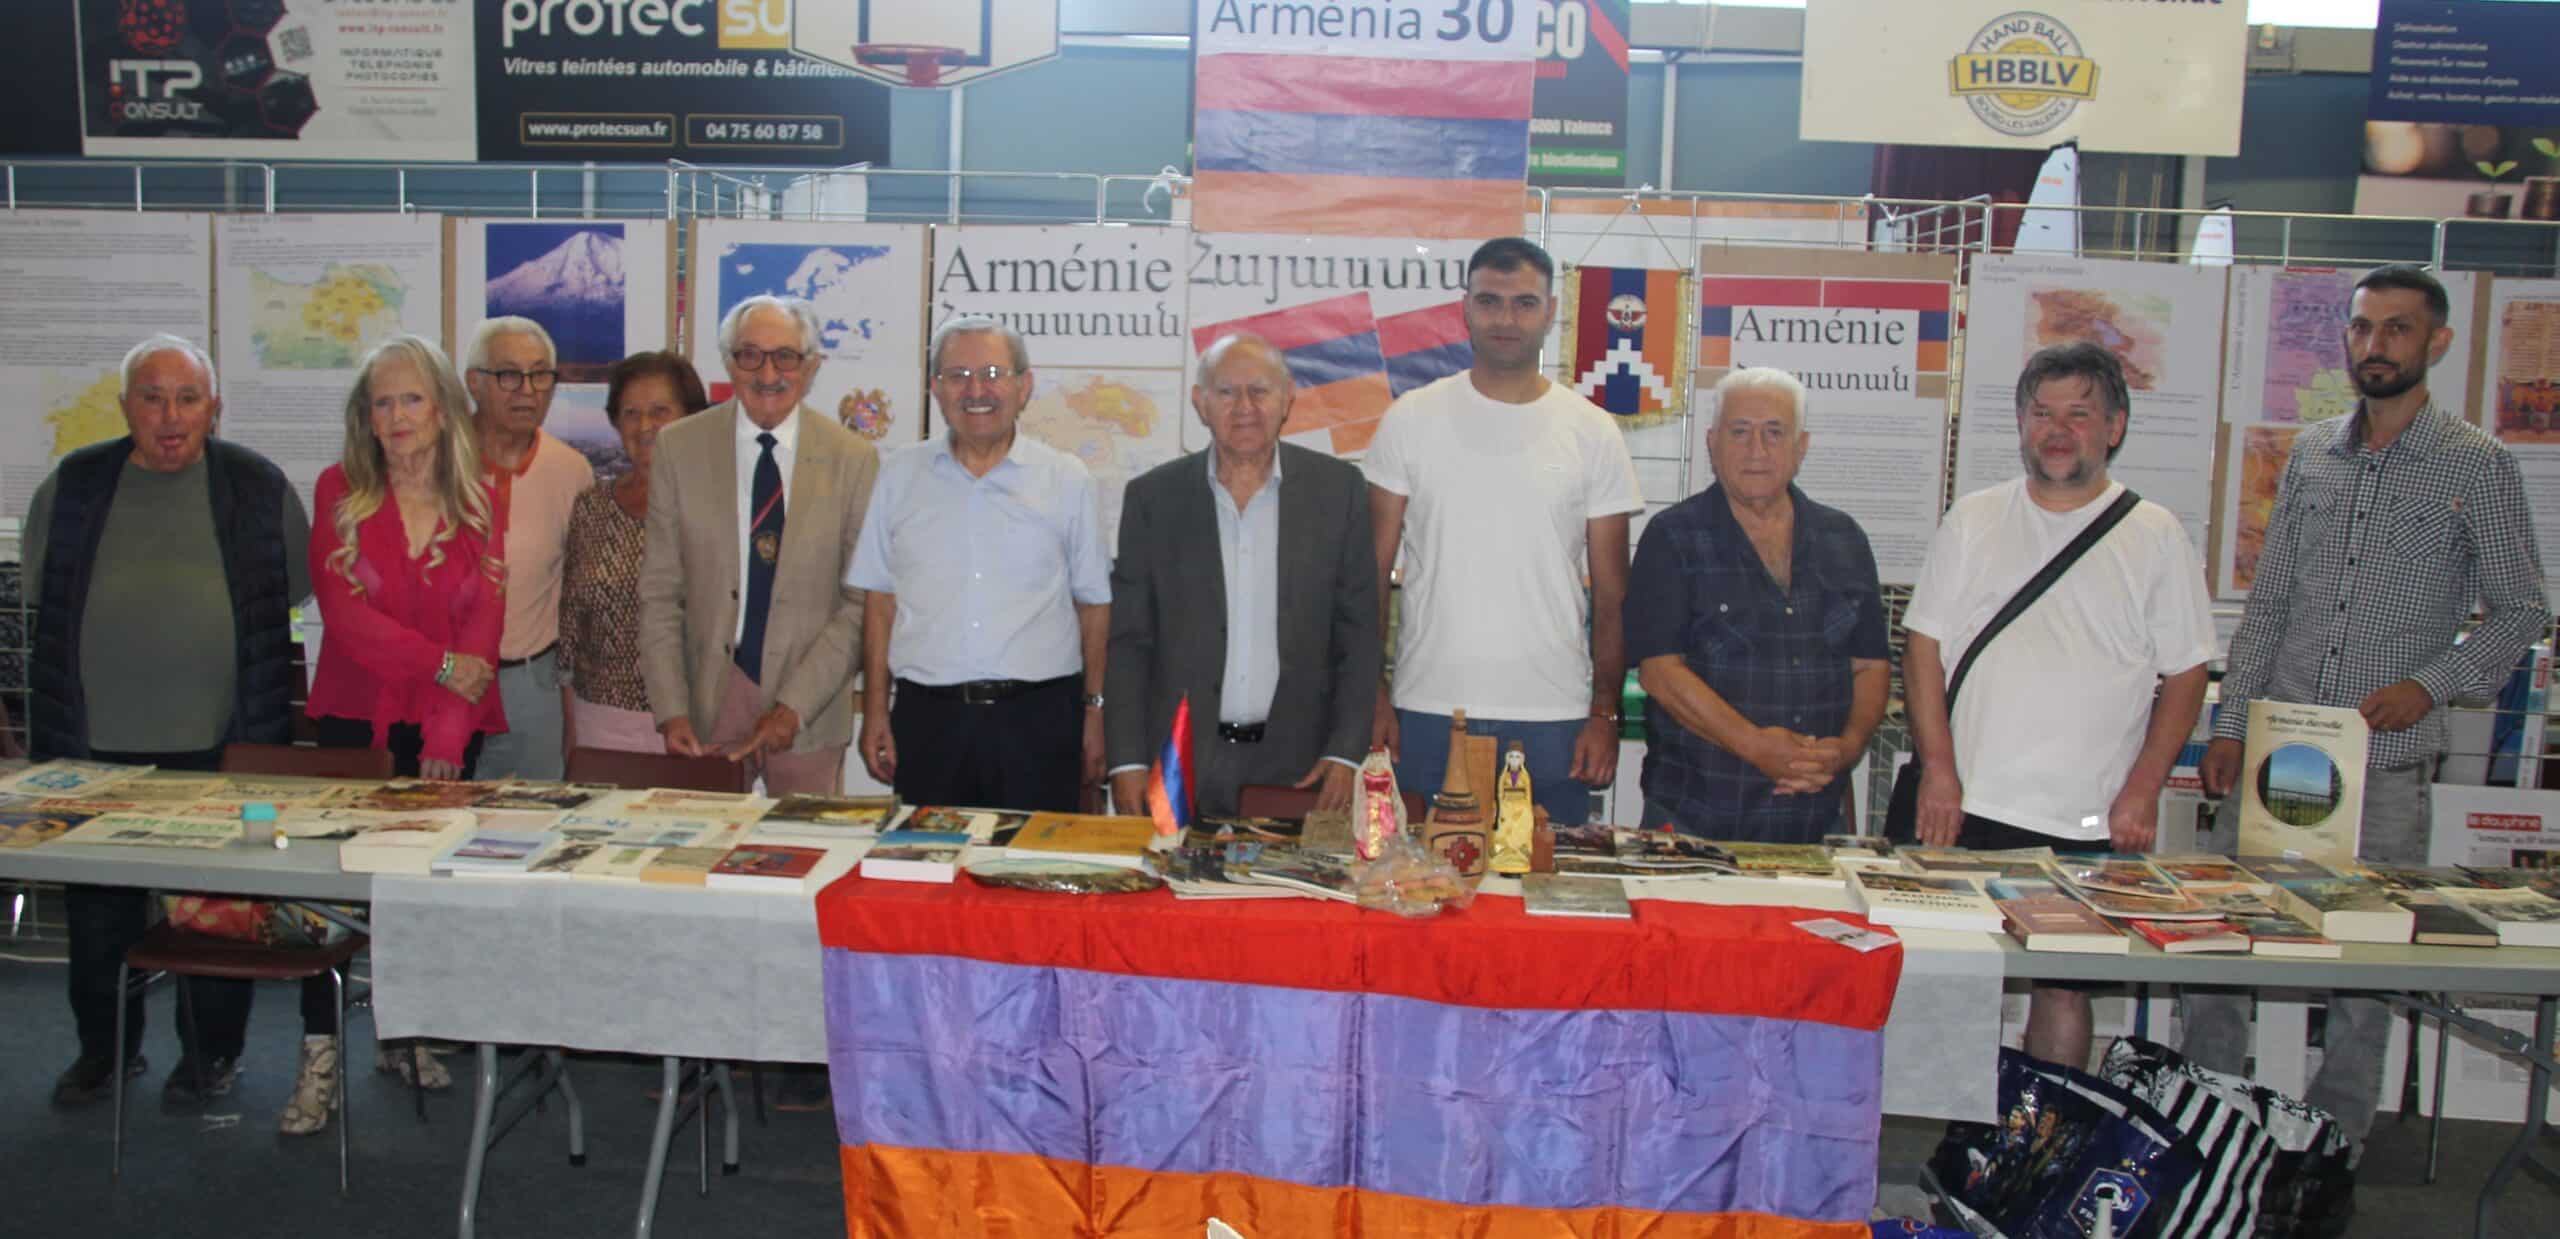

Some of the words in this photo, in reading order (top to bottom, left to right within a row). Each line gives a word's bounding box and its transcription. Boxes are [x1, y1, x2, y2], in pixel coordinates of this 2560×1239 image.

[1436, 0, 1514, 43] 30
[1981, 19, 2031, 52] HAND
[2034, 20, 2068, 56] BALL
[339, 48, 443, 58] INFORMATIQUE
[344, 72, 439, 82] PHOTOCOPIES
[503, 58, 556, 76] Vitres
[562, 57, 636, 76] teintées
[641, 58, 748, 77] automobile
[753, 59, 768, 77] &
[1970, 59, 2081, 87] HBBLV
[528, 121, 669, 139] www.protecsun.fr
[706, 122, 727, 139] 04
[730, 123, 751, 139] 75
[754, 123, 775, 139] 60
[777, 123, 799, 139] 87
[802, 123, 823, 140] 58
[938, 242, 1173, 293] Arménie
[1734, 308, 1905, 346] Arménie
